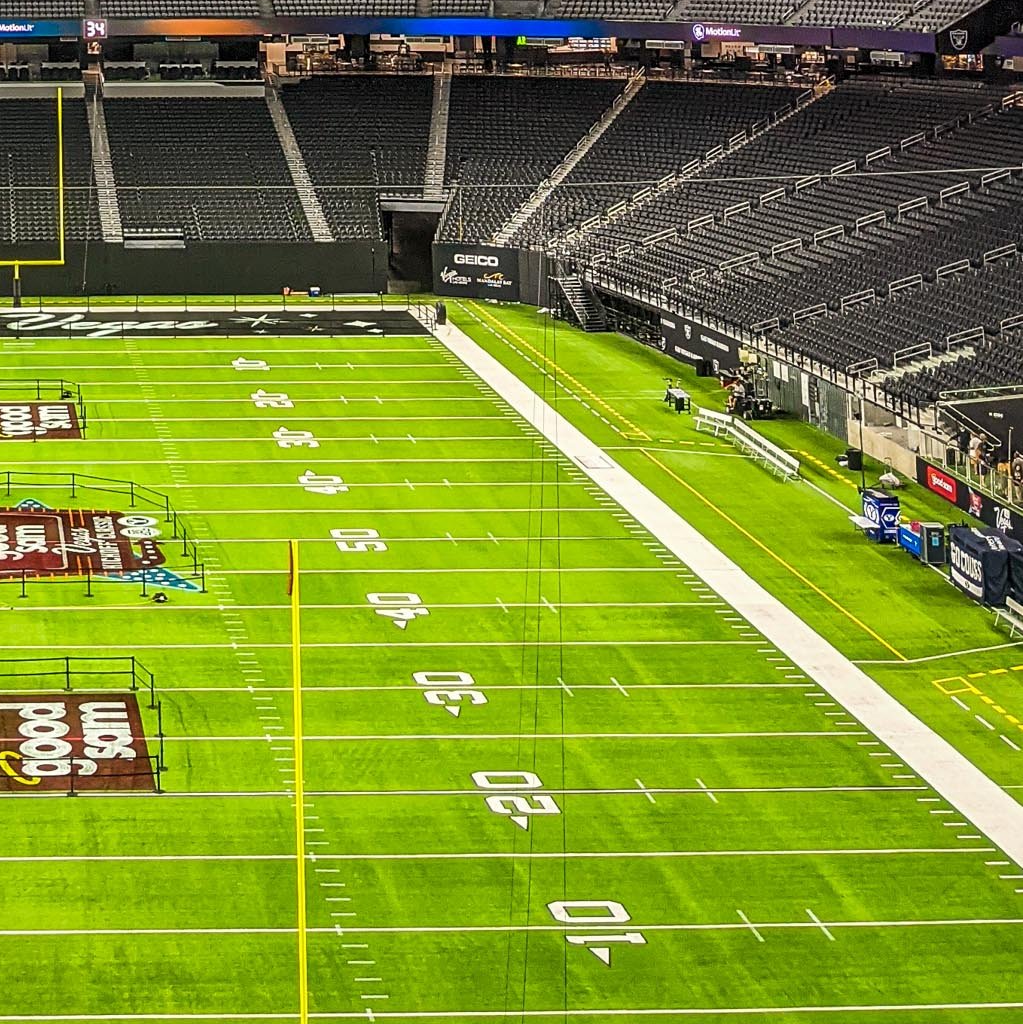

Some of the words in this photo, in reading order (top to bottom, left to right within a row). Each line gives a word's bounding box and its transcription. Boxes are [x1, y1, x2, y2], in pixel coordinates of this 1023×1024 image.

[86, 21, 105, 37] 34
[454, 254, 499, 267] GEICO
[37, 405, 72, 430] sam
[15, 524, 49, 554] sam
[329, 528, 389, 552] 50
[411, 671, 489, 705] 30
[78, 702, 137, 761] sam
[471, 771, 562, 815] 20
[546, 900, 648, 945] 10
